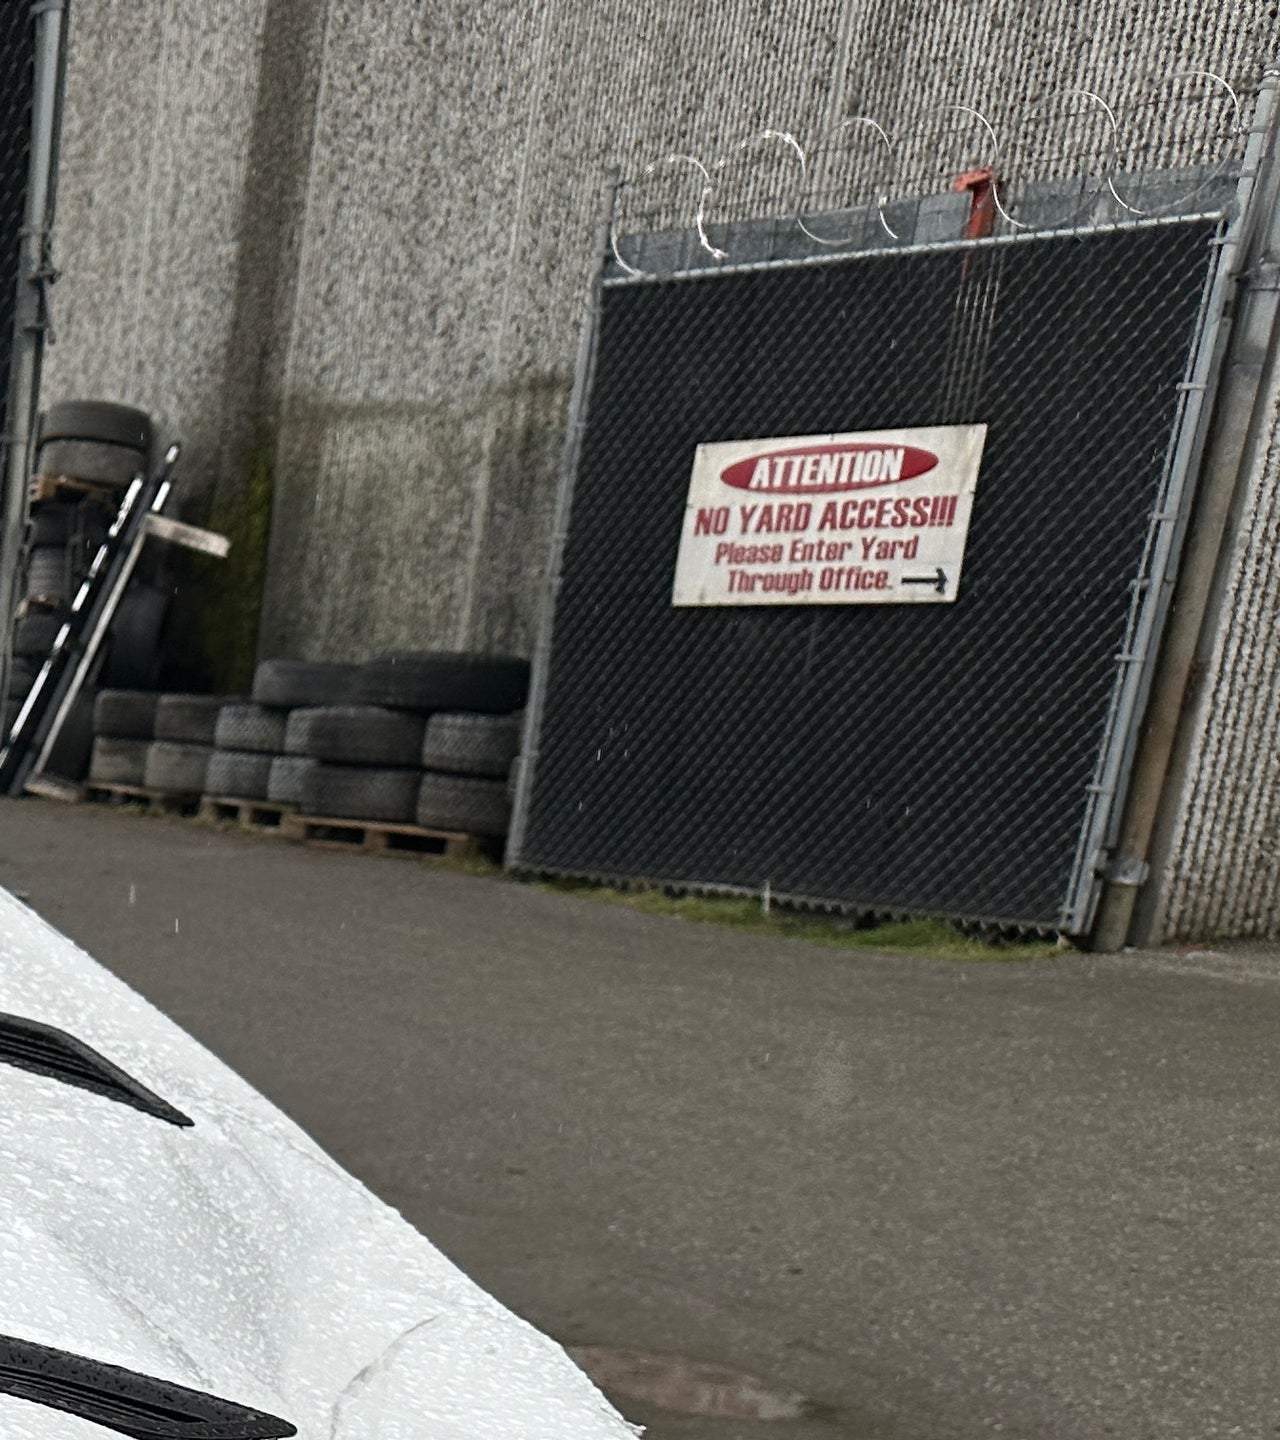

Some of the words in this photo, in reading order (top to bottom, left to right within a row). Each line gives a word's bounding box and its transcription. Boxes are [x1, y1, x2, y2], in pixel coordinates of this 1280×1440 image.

[747, 448, 906, 489] ATTENTION
[693, 505, 730, 536] NO
[739, 501, 812, 534] YARD
[816, 494, 959, 531] ACCESS!!!
[713, 541, 782, 565] Please
[788, 539, 853, 563] Enter
[859, 535, 920, 560] Yard
[726, 565, 813, 594] Through
[818, 565, 894, 591] Office.
